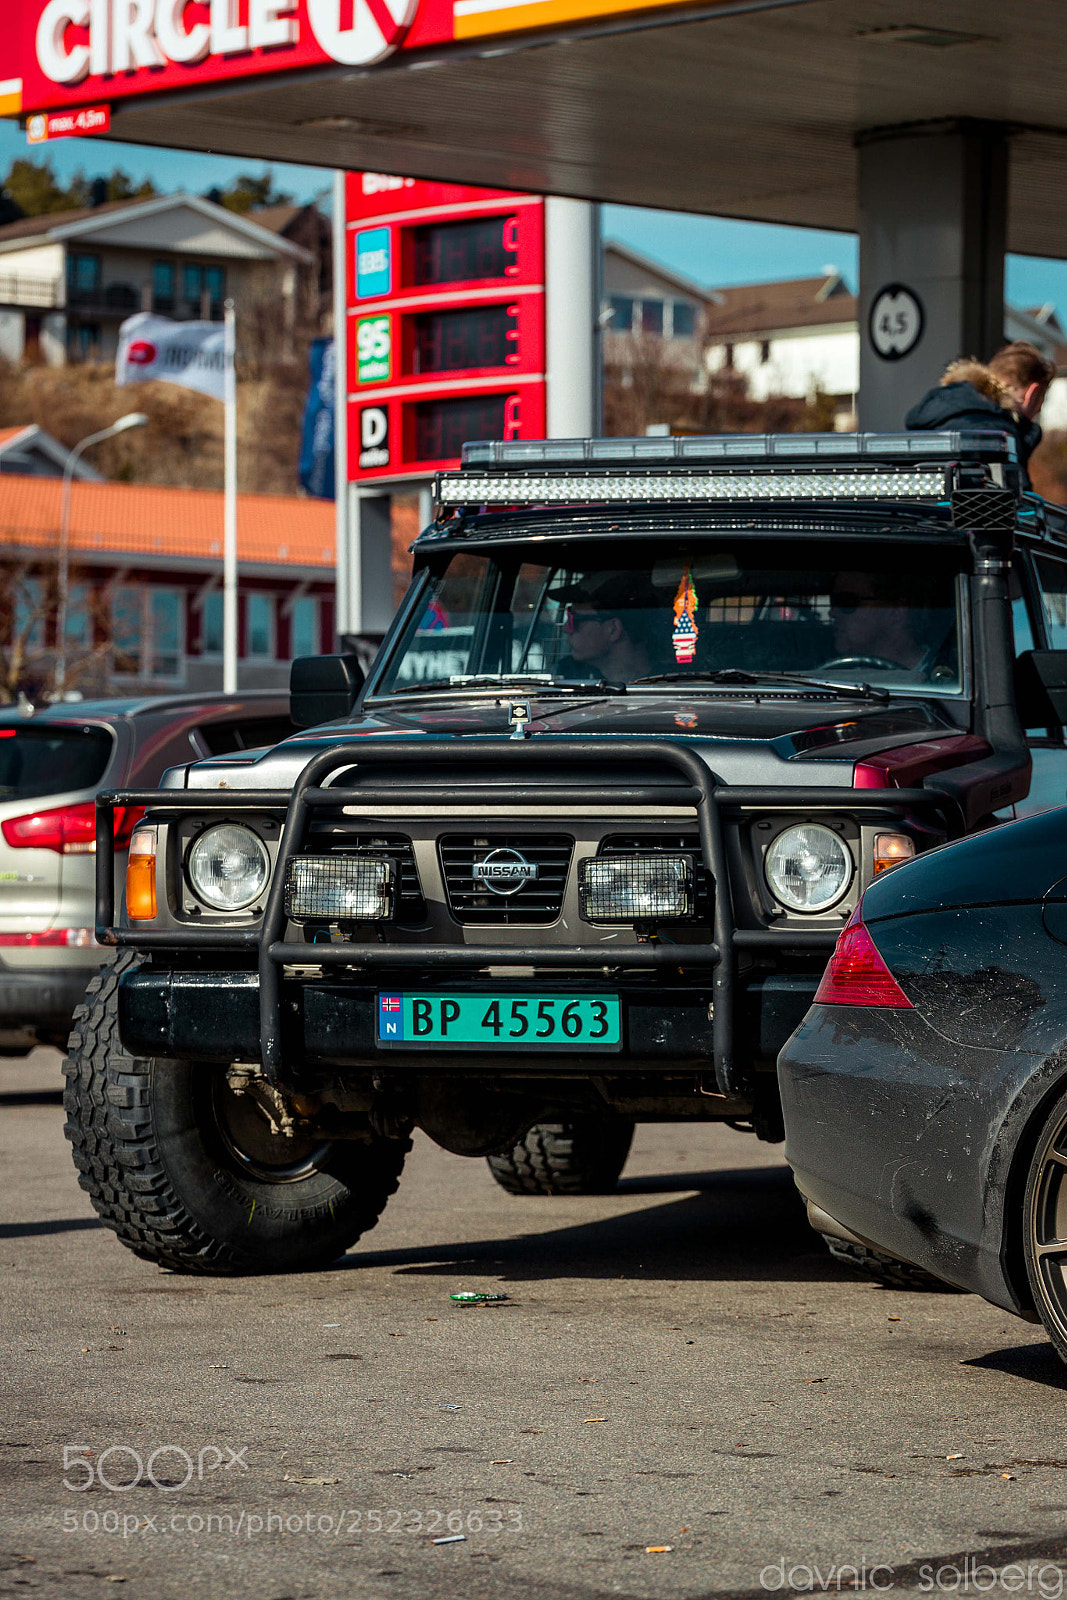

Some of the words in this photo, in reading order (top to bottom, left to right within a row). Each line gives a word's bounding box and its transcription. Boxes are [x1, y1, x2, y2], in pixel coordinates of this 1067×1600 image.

[36, 0, 298, 83] CIRCLE
[357, 319, 391, 361] 95
[361, 407, 388, 449] D
[477, 866, 531, 877] NISSAN
[386, 1022, 397, 1034] N
[412, 999, 461, 1036] BP
[481, 1000, 609, 1038] 45563
